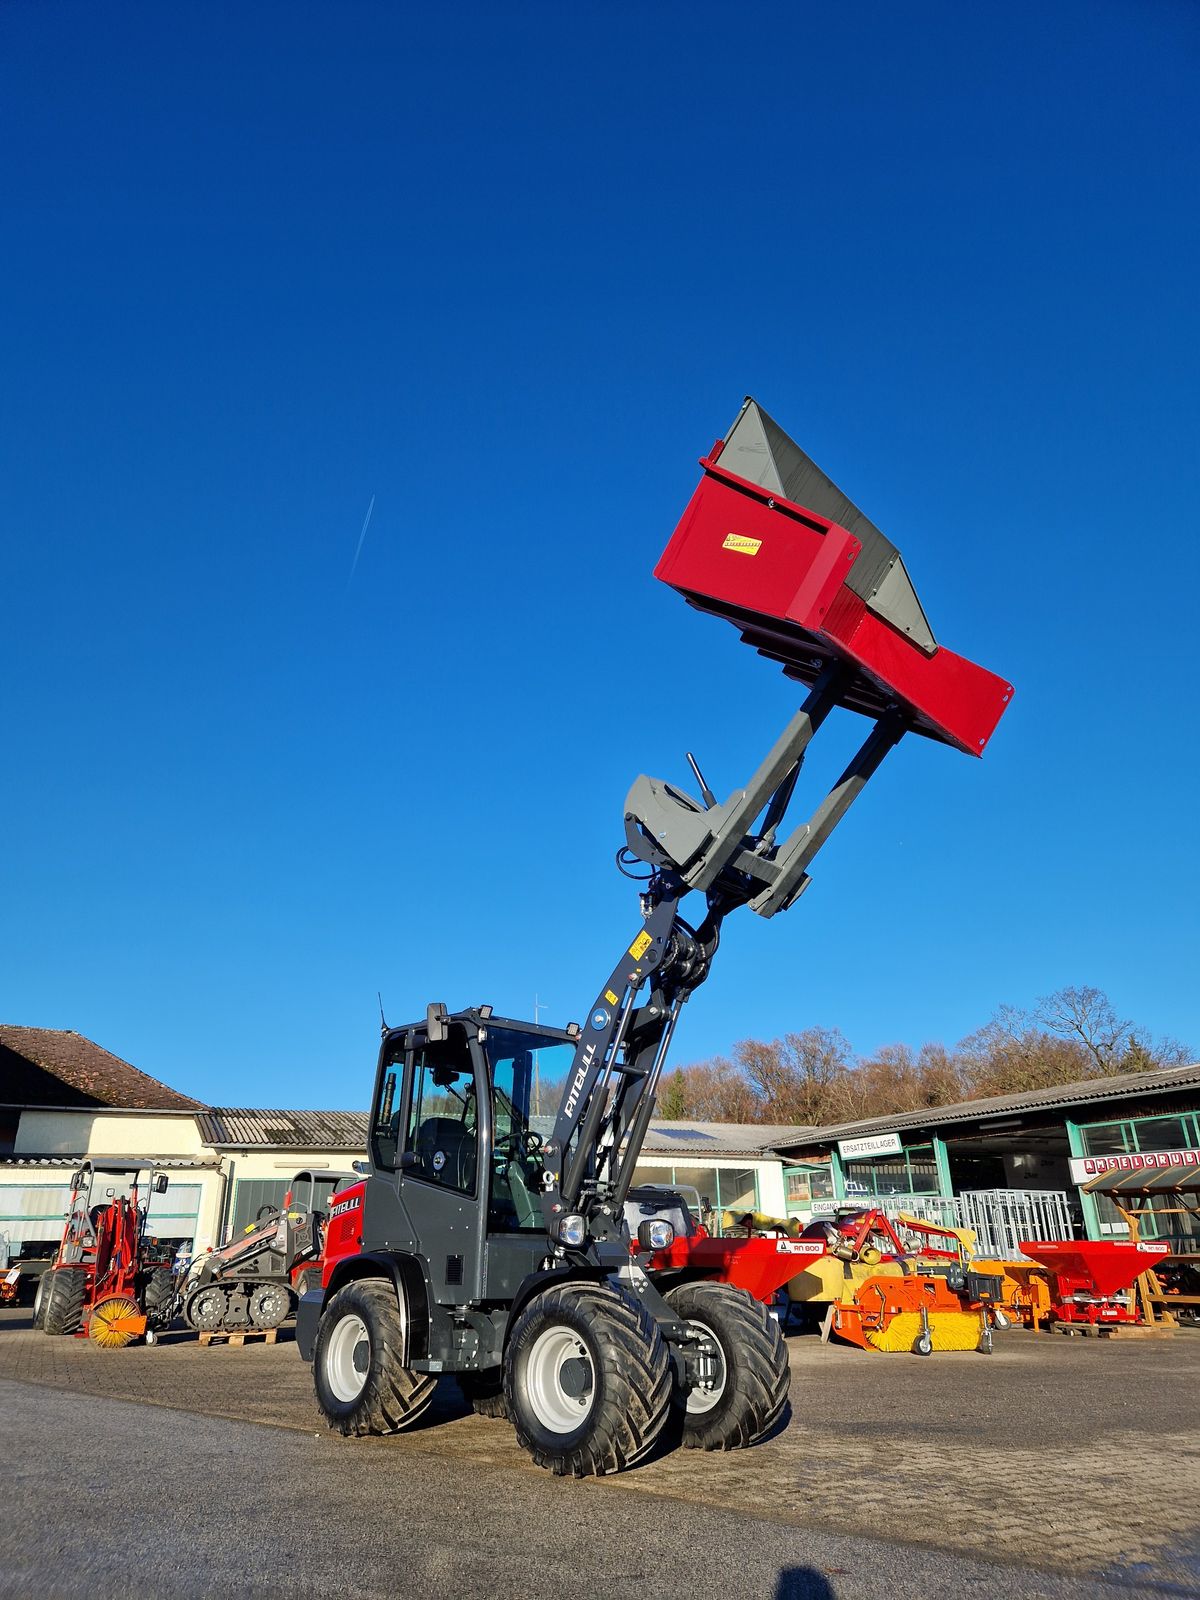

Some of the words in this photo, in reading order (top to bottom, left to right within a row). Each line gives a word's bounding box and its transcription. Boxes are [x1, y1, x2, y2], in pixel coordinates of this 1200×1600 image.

[564, 1044, 597, 1119] PITBULL
[843, 1139, 896, 1153] ERSATZTEILLAGER
[1086, 1152, 1199, 1171] AMSELGRUB
[330, 1197, 360, 1219] PITBULL
[813, 1202, 839, 1212] EINGANG
